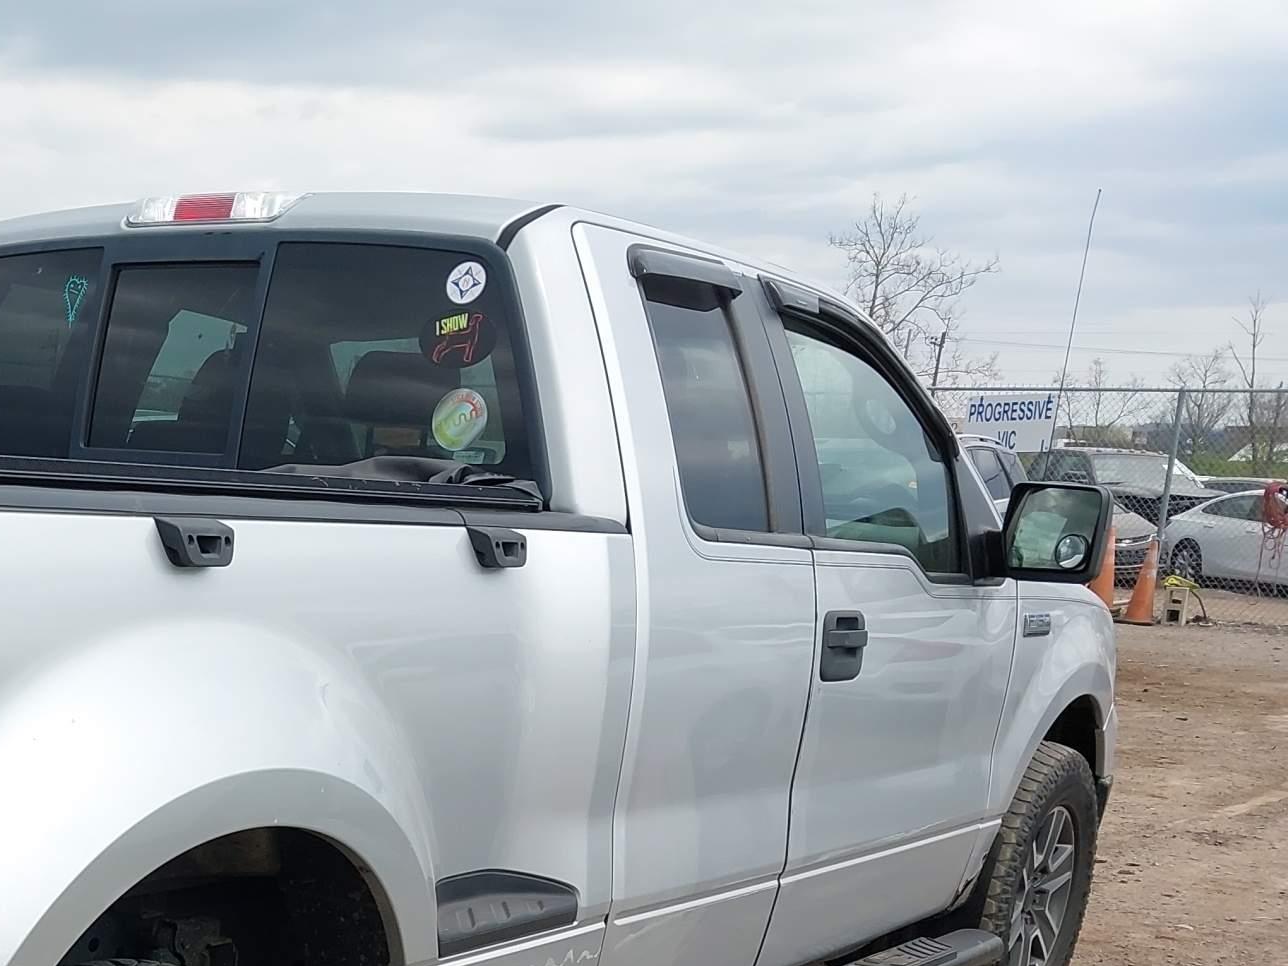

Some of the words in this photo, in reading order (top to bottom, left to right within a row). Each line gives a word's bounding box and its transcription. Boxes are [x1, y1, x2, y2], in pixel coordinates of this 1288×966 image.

[441, 313, 469, 335] SHOW
[968, 399, 1053, 423] PROGRESSIVE
[997, 430, 1017, 450] VIC
